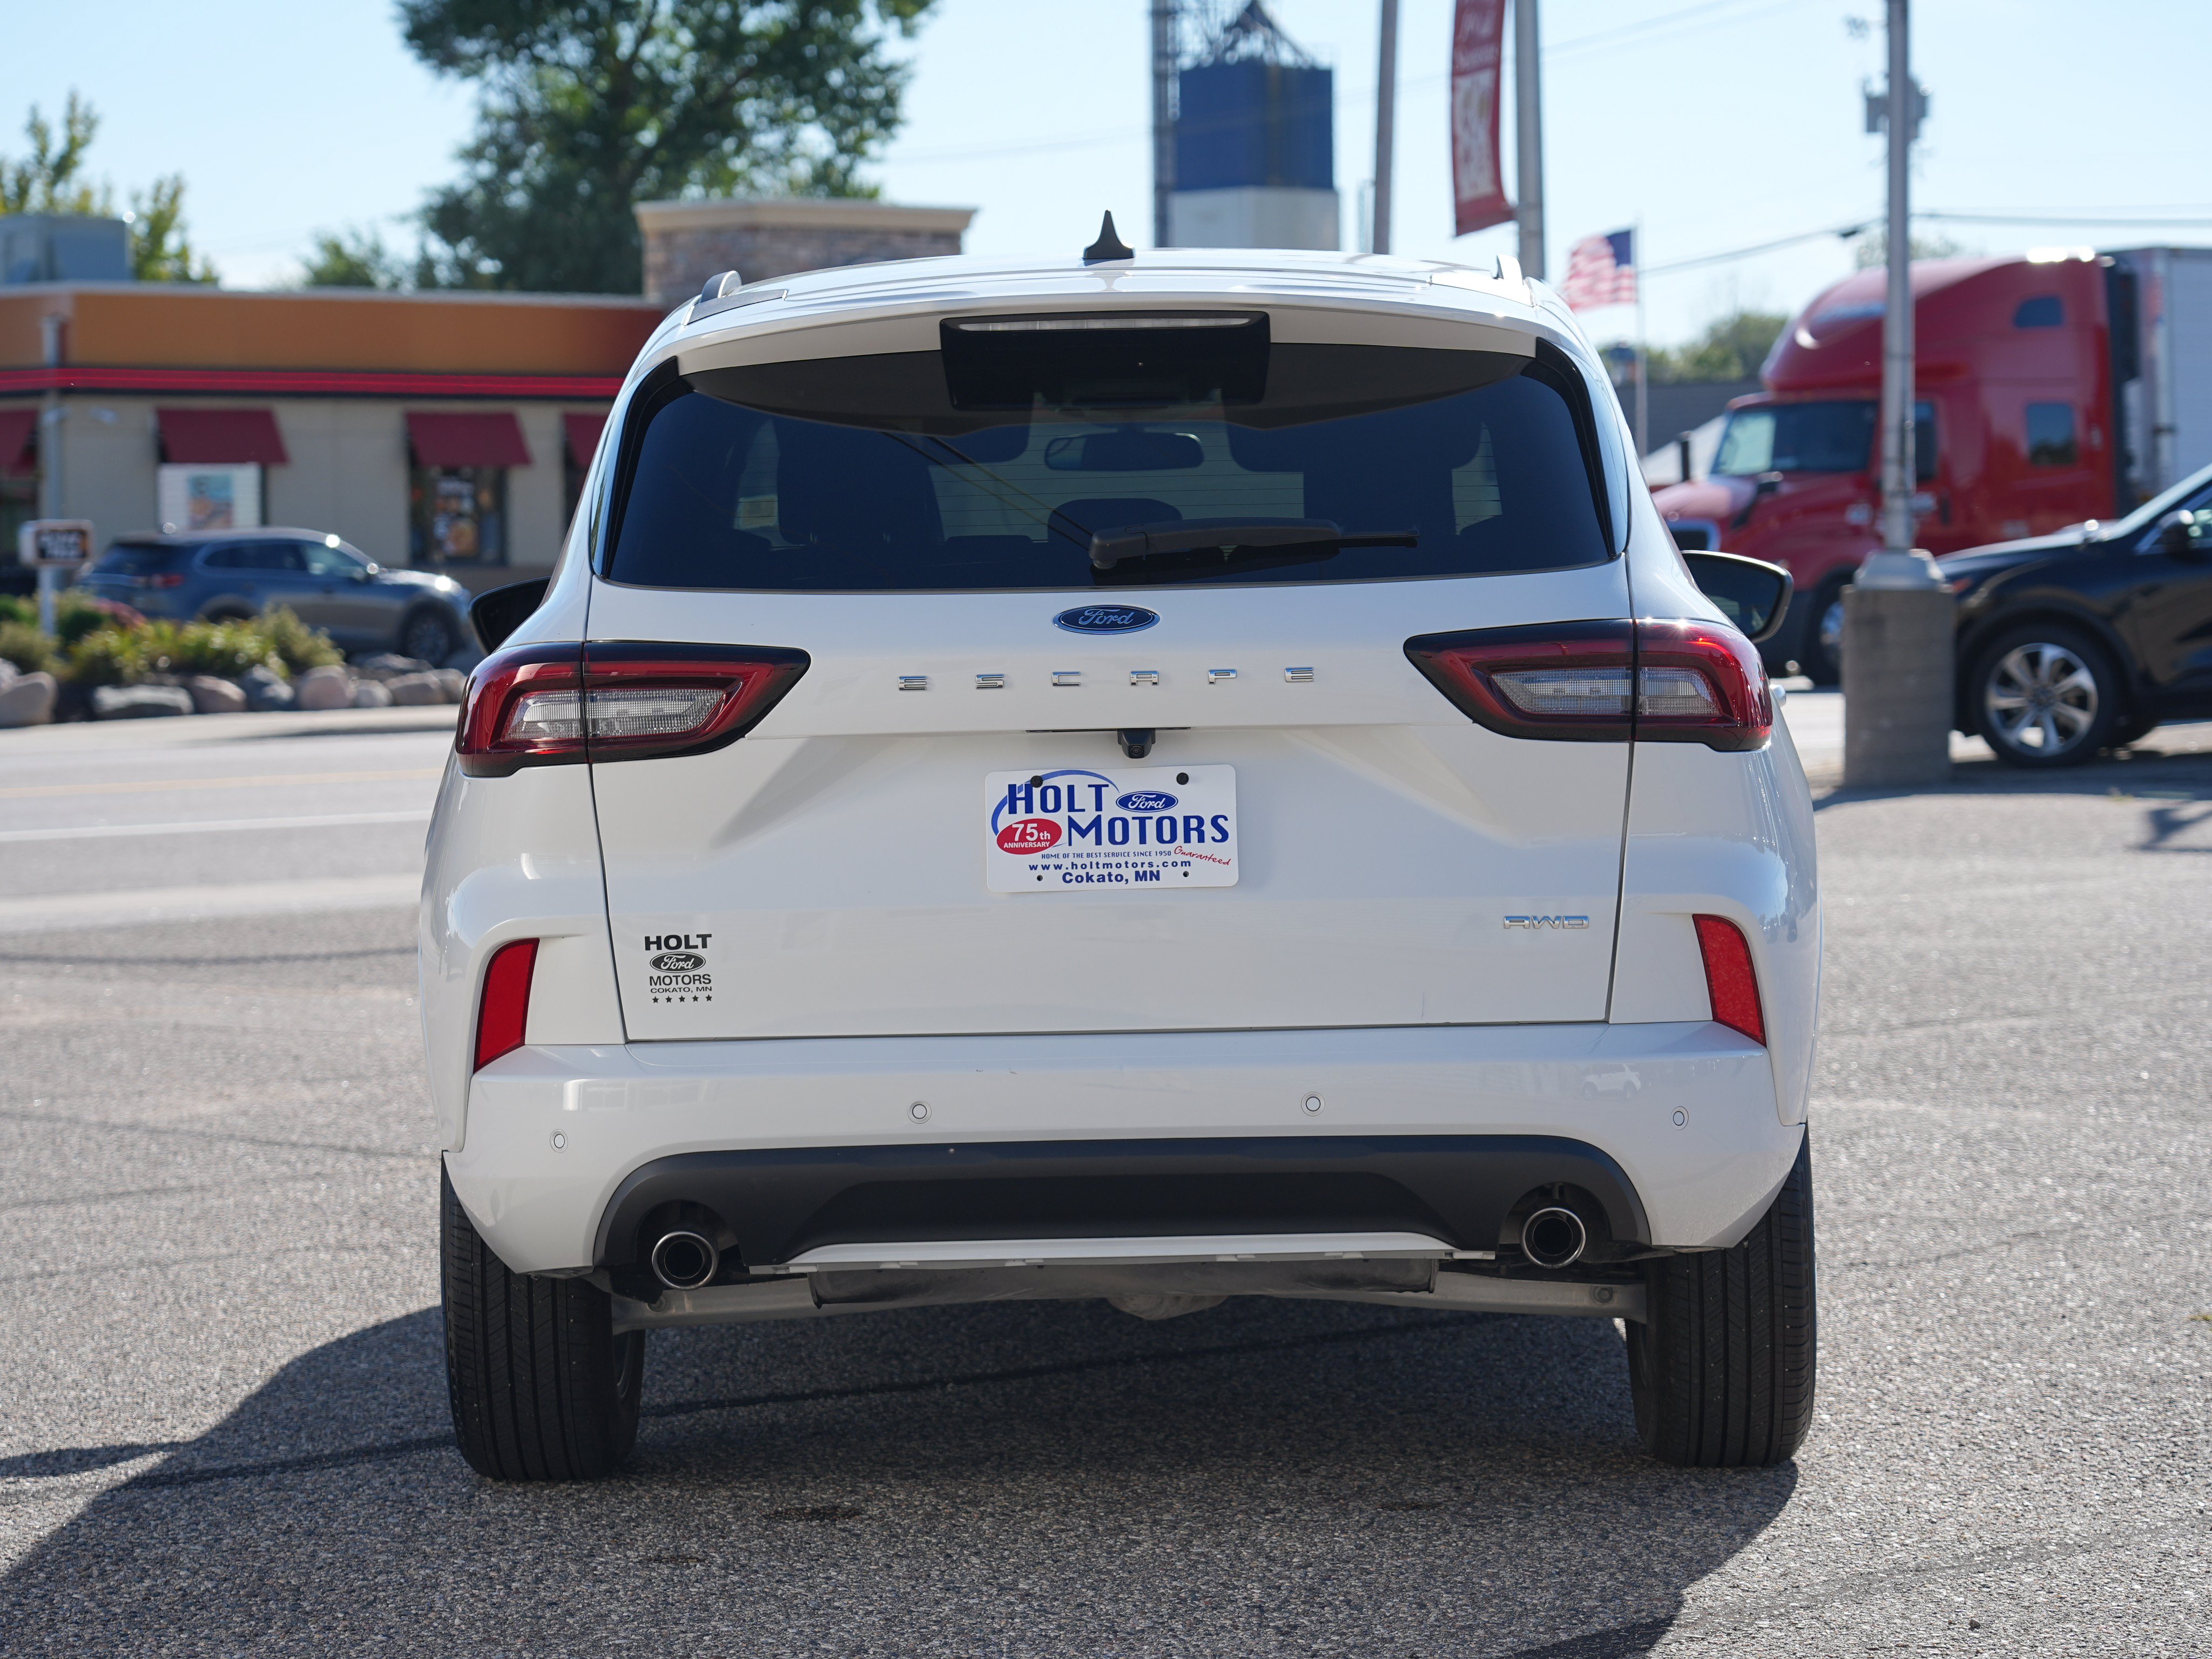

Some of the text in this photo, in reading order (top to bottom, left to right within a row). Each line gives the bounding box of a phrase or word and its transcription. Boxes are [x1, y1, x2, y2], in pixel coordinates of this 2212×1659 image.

[898, 666, 1314, 691] ESCAPE
[1008, 784, 1109, 814] HOLT
[1011, 822, 1051, 841] 75th
[1068, 814, 1230, 846] MOTORS
[1174, 845, 1232, 866] Guaranteed
[1028, 860, 1191, 871] www.holtmotors.com
[1062, 870, 1161, 885] Cokato, MN
[1504, 915, 1589, 929] AWD
[644, 933, 712, 950] HOLT
[649, 974, 712, 986] MOTORS
